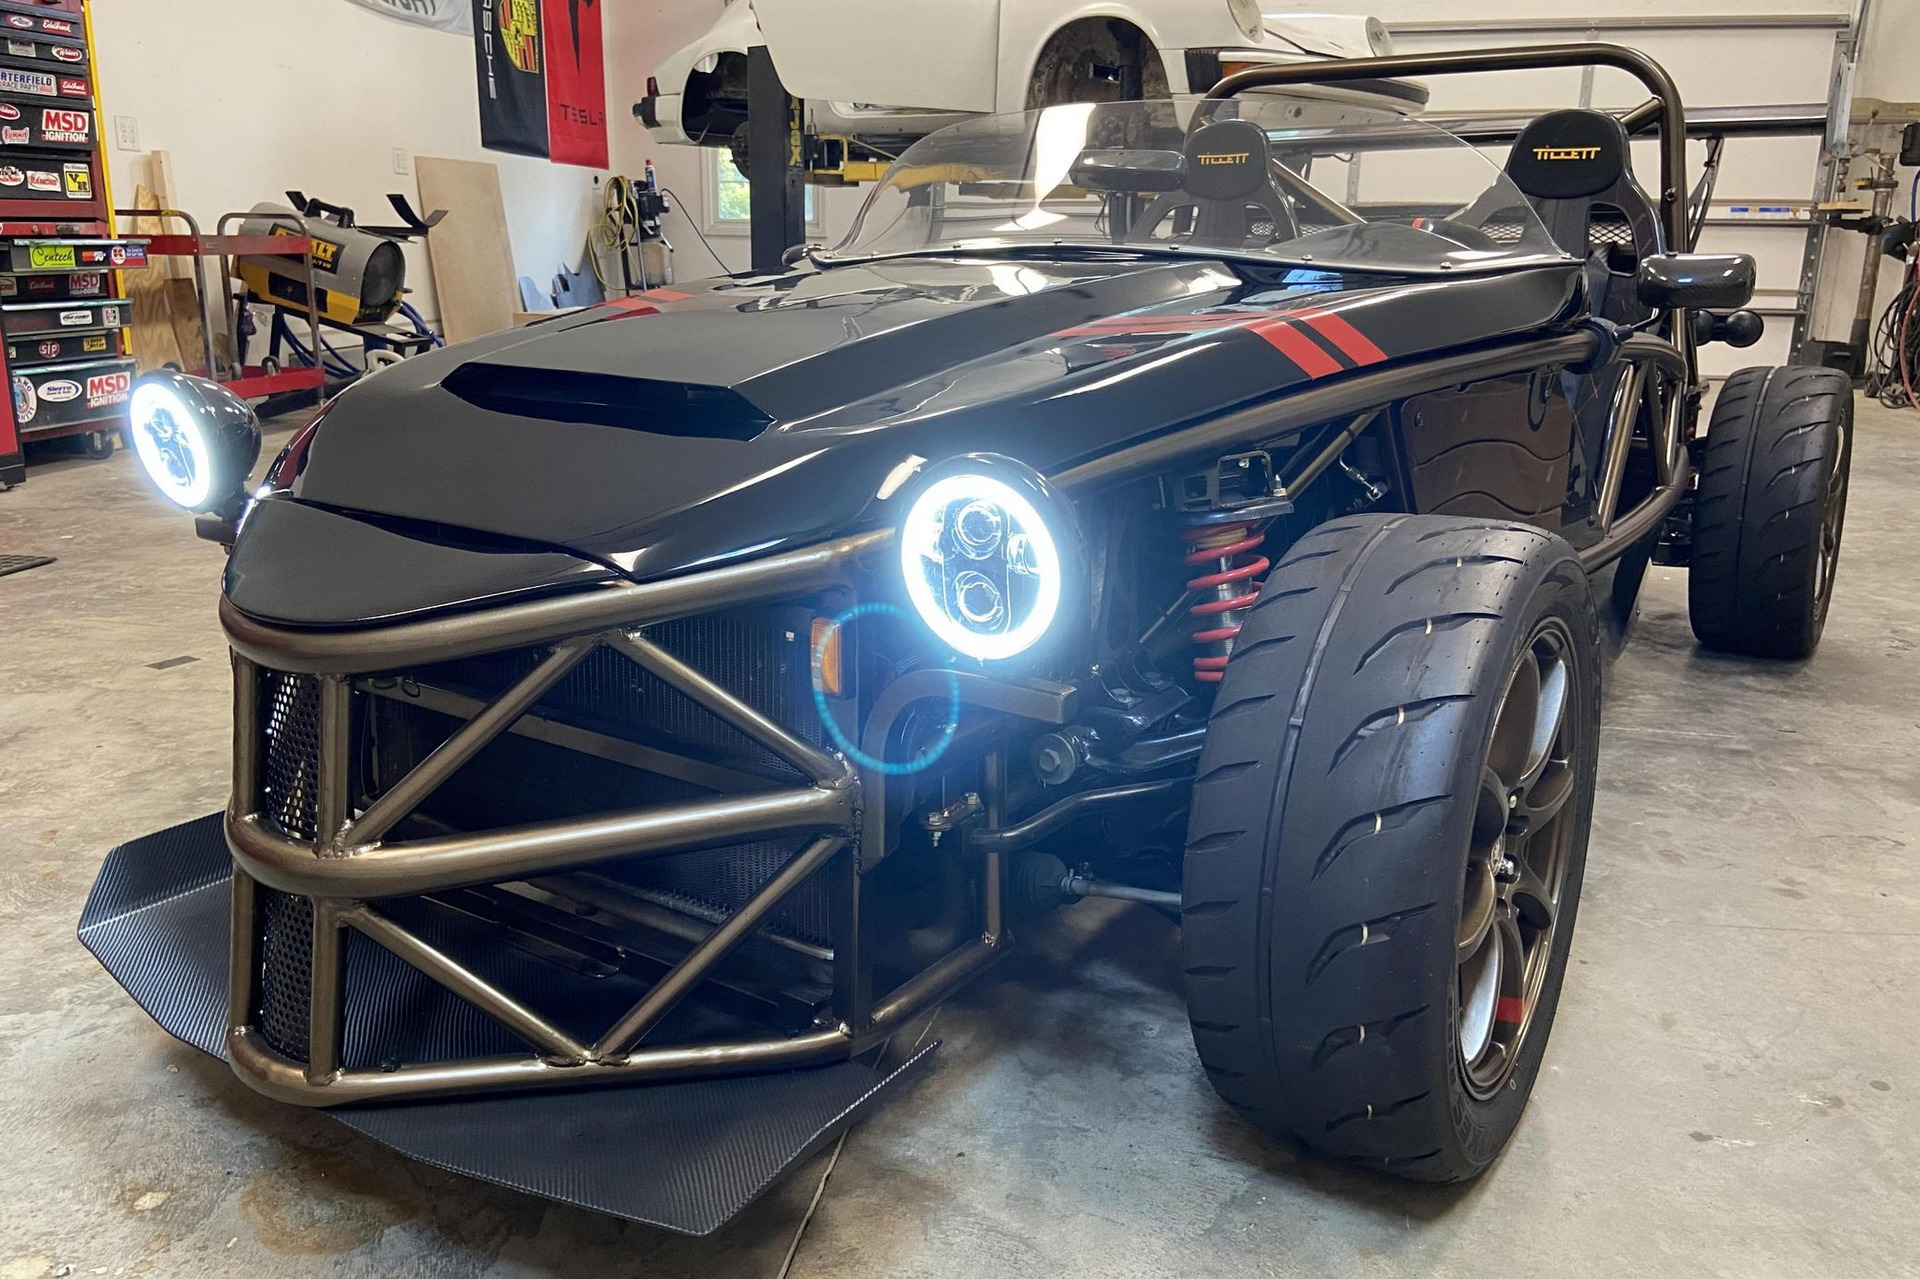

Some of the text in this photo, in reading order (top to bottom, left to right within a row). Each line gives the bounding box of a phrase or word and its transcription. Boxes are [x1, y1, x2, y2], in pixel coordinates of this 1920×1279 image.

[2, 81, 39, 91] RACE PARTS
[45, 110, 87, 132] MSD
[559, 104, 604, 125] TESLA
[45, 131, 85, 142] IGNITION
[32, 246, 73, 266] Centech
[70, 274, 99, 288] MSD
[41, 341, 57, 354] STP
[89, 374, 129, 397] MSD
[90, 394, 128, 408] IGNITION
